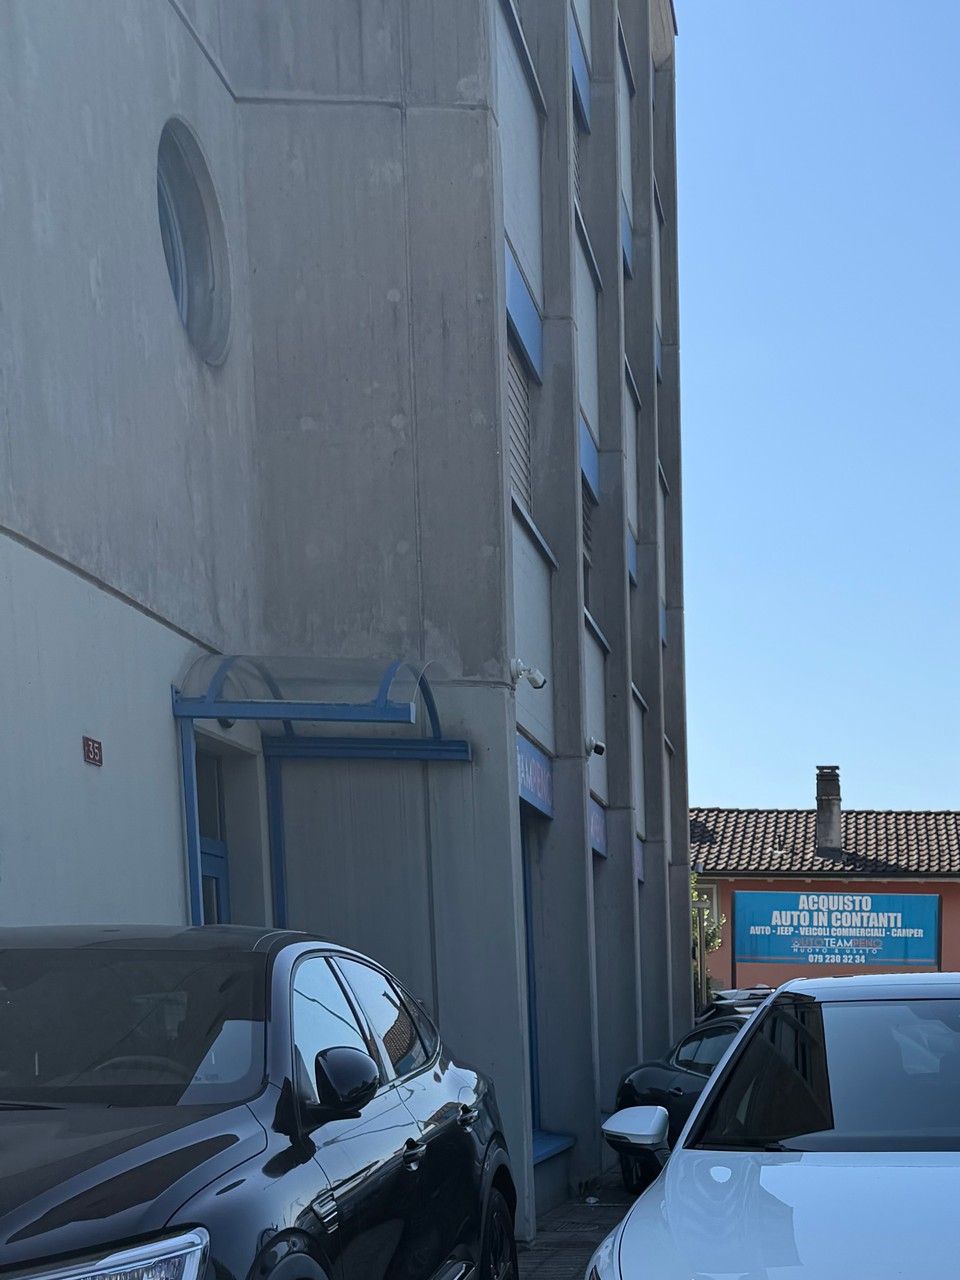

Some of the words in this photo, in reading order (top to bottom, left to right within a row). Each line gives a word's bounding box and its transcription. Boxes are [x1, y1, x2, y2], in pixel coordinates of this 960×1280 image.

[88, 741, 100, 760] 35
[799, 895, 872, 911] ACQUISTO
[771, 911, 810, 926] AUTO
[813, 912, 828, 927] IN
[831, 912, 902, 928] CONTANTI
[750, 926, 771, 935] AUTO
[776, 927, 794, 935] JEEP
[800, 927, 830, 936] VEICOLI
[831, 928, 885, 937] COMMERCIALI
[891, 929, 924, 937] CAMPER
[808, 954, 823, 963] 079
[842, 955, 853, 963] 32
[854, 955, 866, 963] 34
